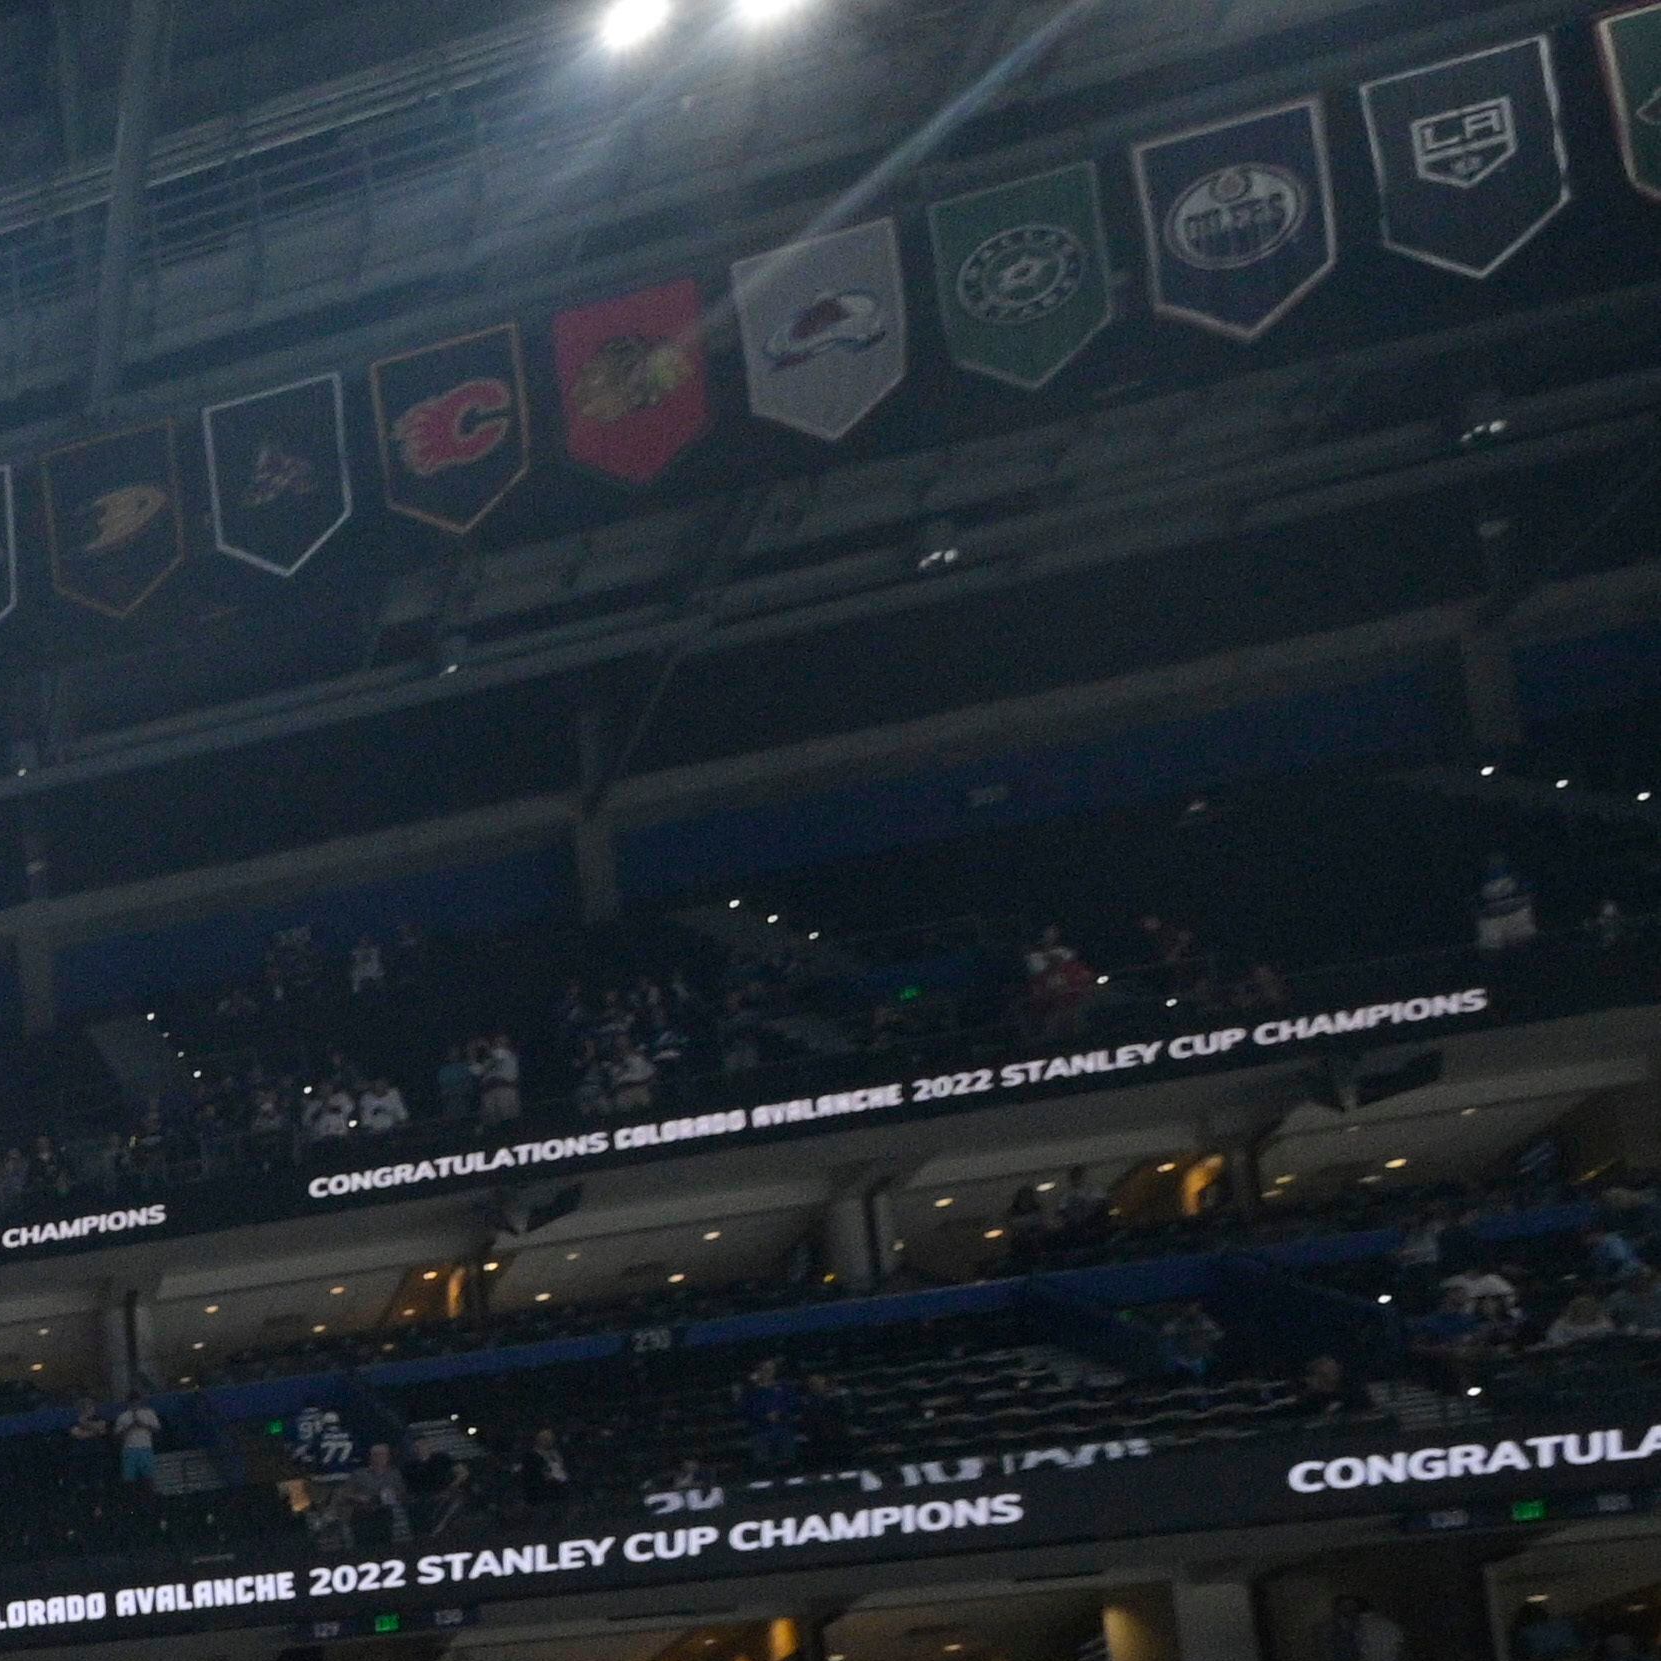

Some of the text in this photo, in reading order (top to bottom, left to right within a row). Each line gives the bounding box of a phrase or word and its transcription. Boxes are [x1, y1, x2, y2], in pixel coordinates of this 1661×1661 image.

[309, 989, 1487, 1197] CONGRATULATIONS COLORADO AVALANCHE 2022 STANLEY CUP CHAMPIONS
[2, 1205, 166, 1248] CHAMPIONS
[116, 1572, 295, 1616] AVALANCHE
[310, 1560, 406, 1595] 2022
[417, 1537, 615, 1584] STANLEY
[624, 1527, 719, 1562] CUP
[729, 1494, 1023, 1550] CHAMPIONS
